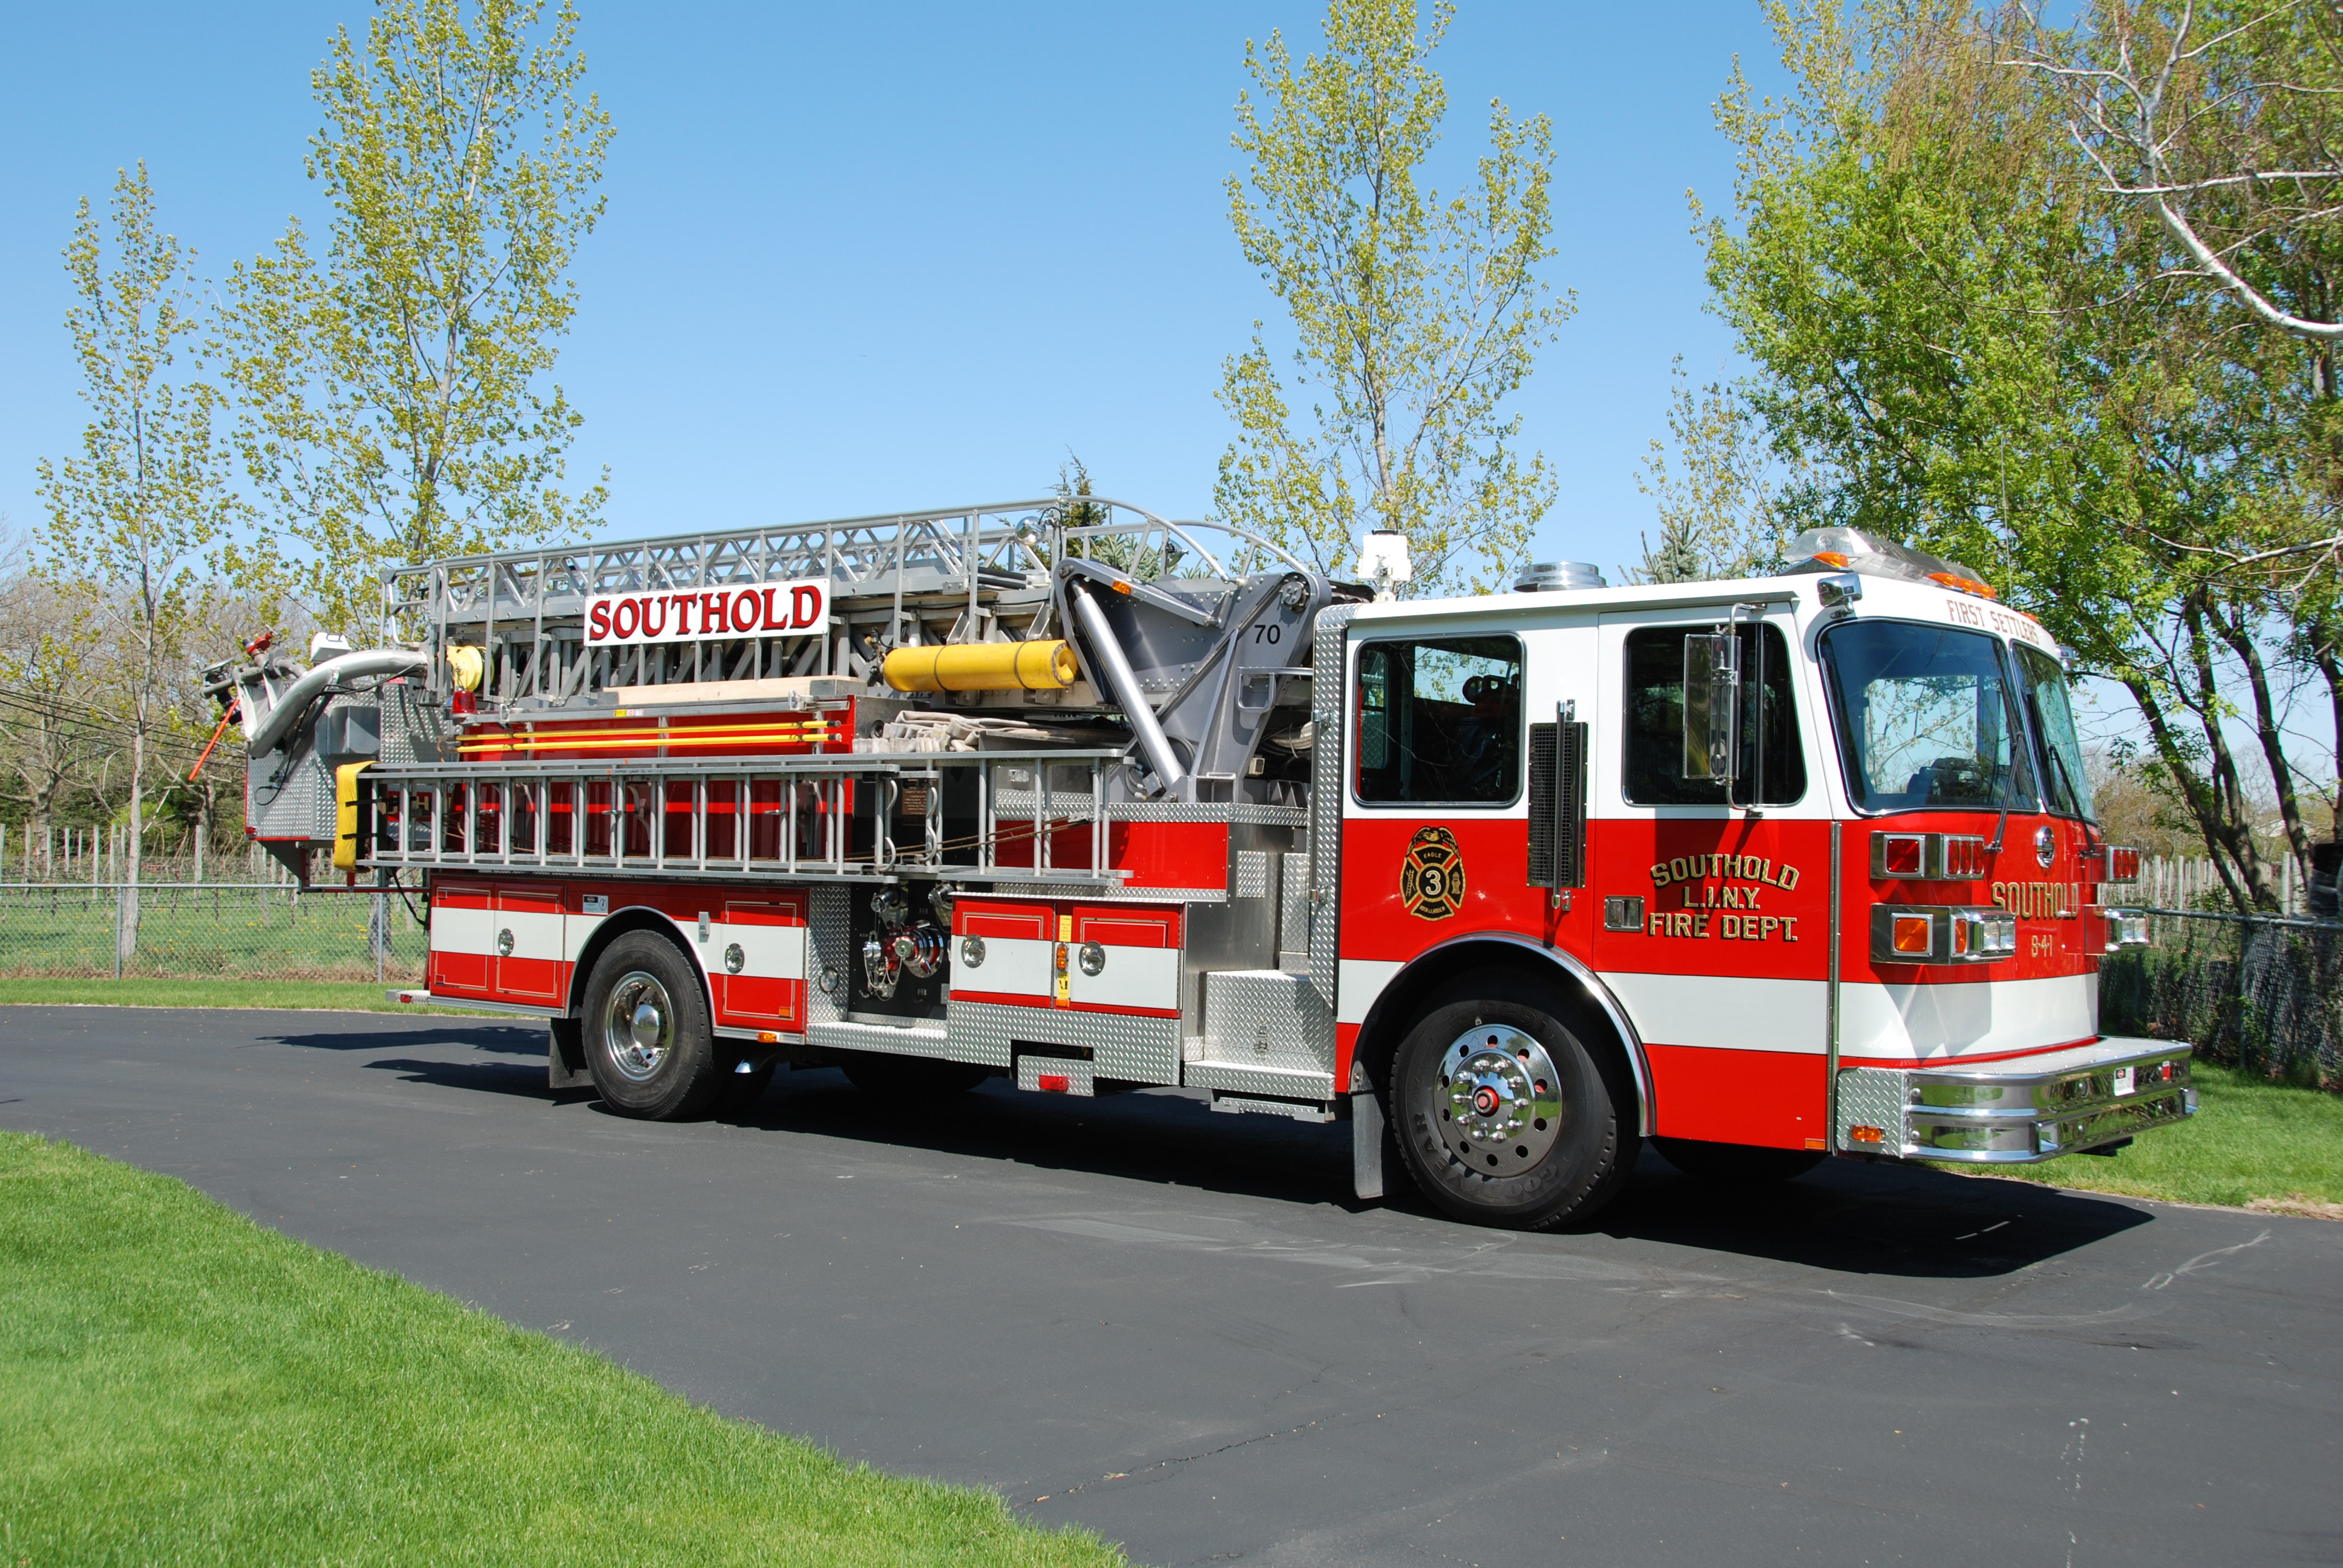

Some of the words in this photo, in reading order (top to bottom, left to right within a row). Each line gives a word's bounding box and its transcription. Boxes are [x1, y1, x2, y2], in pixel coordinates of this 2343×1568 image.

[589, 584, 822, 641] SOUTHOLD
[1946, 599, 1985, 627] FIRST
[1990, 610, 2039, 645] SETTLERS
[1254, 624, 1280, 645] 70
[1425, 870, 1441, 895] 3
[1650, 854, 1800, 891] SOUTHOLD
[1992, 881, 2079, 918] SOUTHOLD
[1648, 912, 1710, 938] FIRE
[1722, 915, 1798, 942] DEPT.
